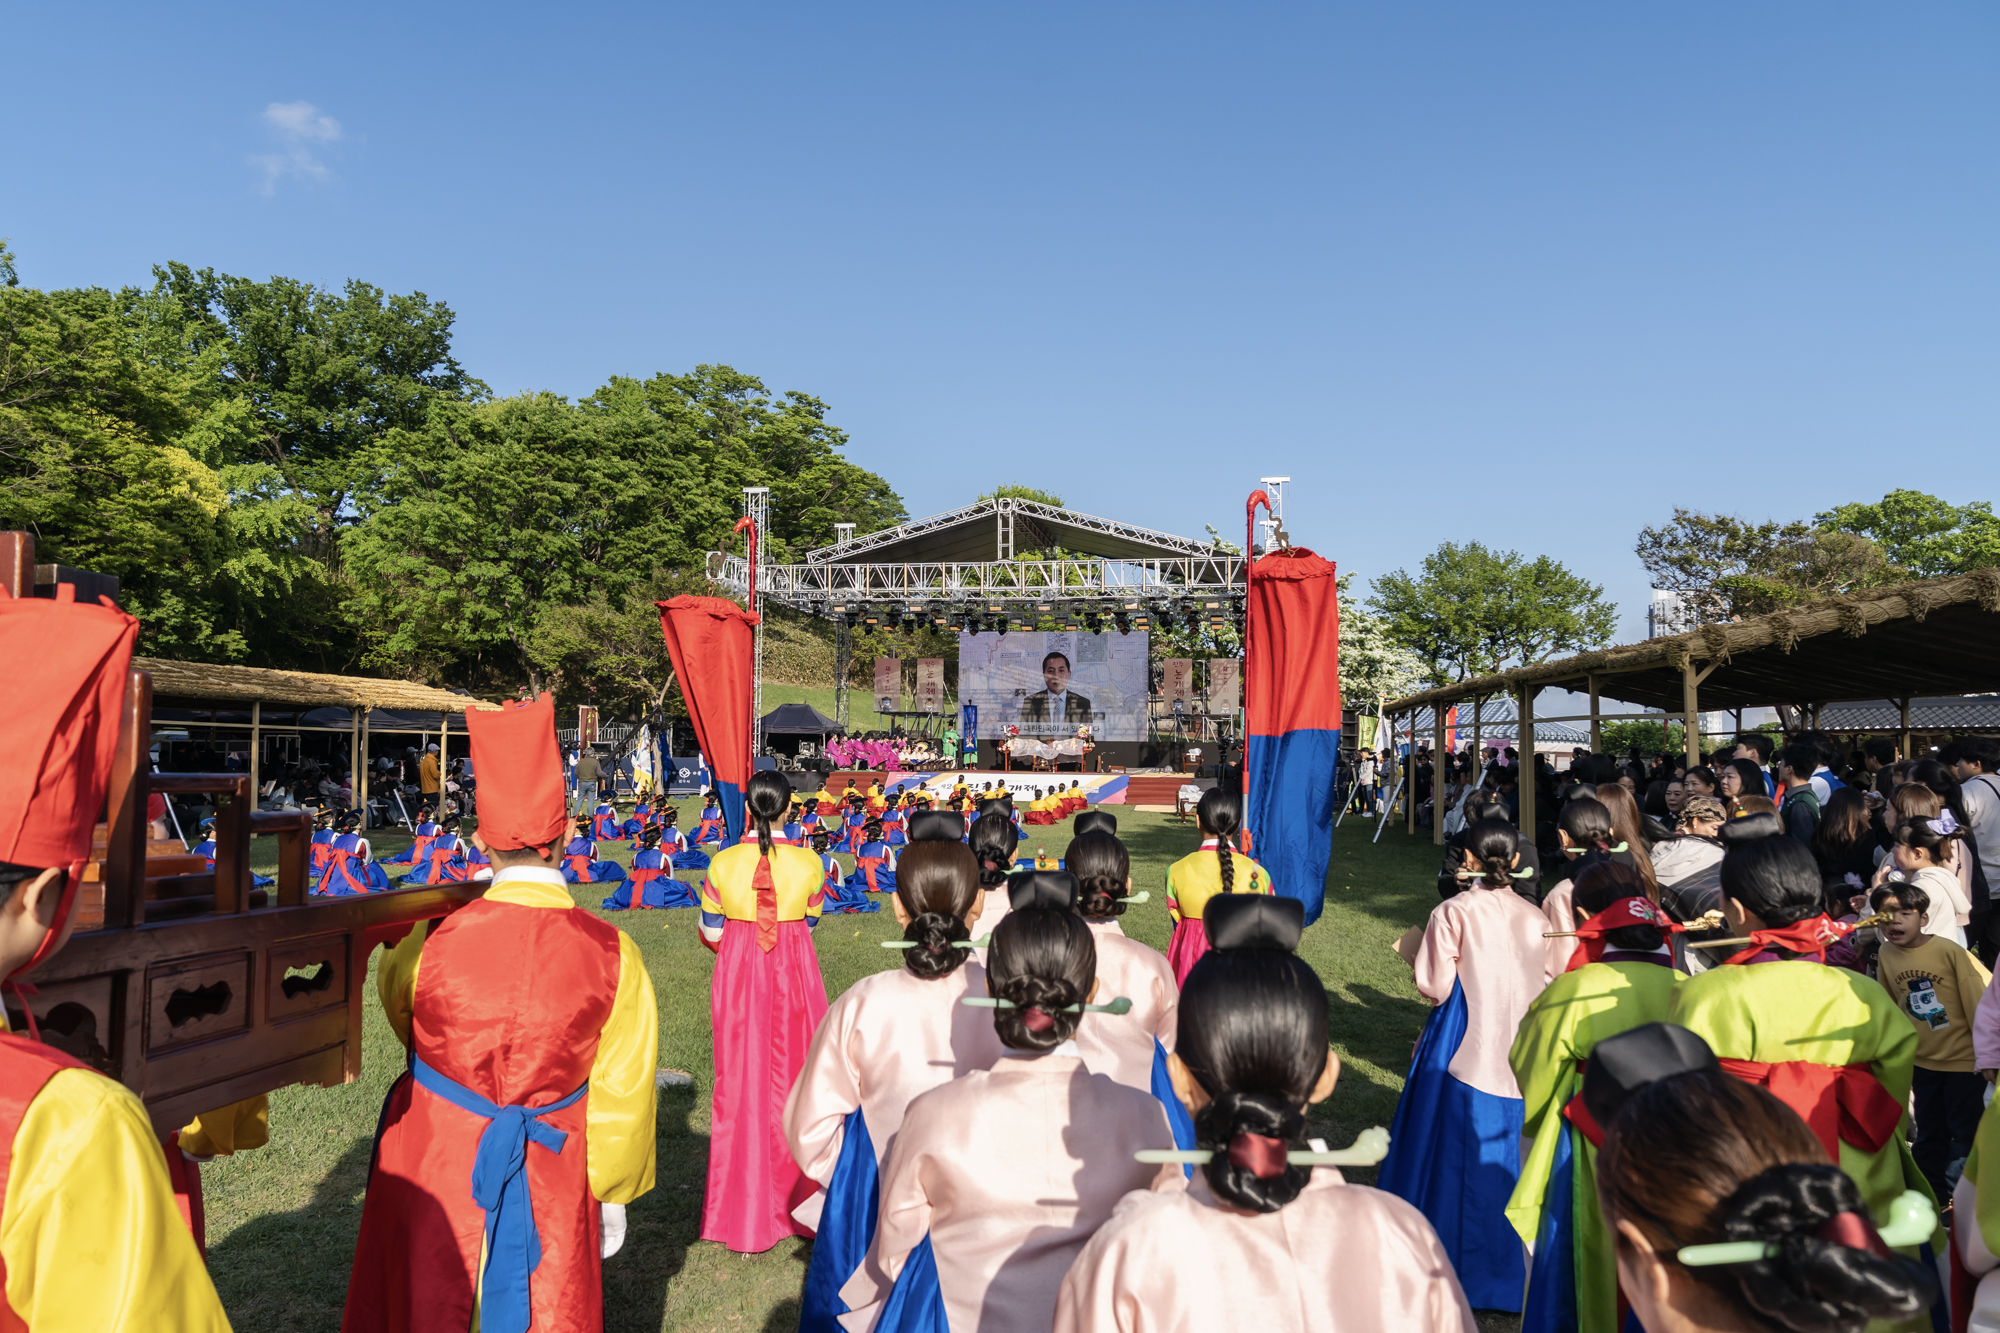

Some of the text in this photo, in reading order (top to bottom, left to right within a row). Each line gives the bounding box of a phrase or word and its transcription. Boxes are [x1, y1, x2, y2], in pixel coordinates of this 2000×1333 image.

[926, 669, 936, 695] 논개제
[1174, 670, 1184, 696] 논개제
[1023, 724, 1060, 733] 대한민국이
[1061, 724, 1069, 733] 서
